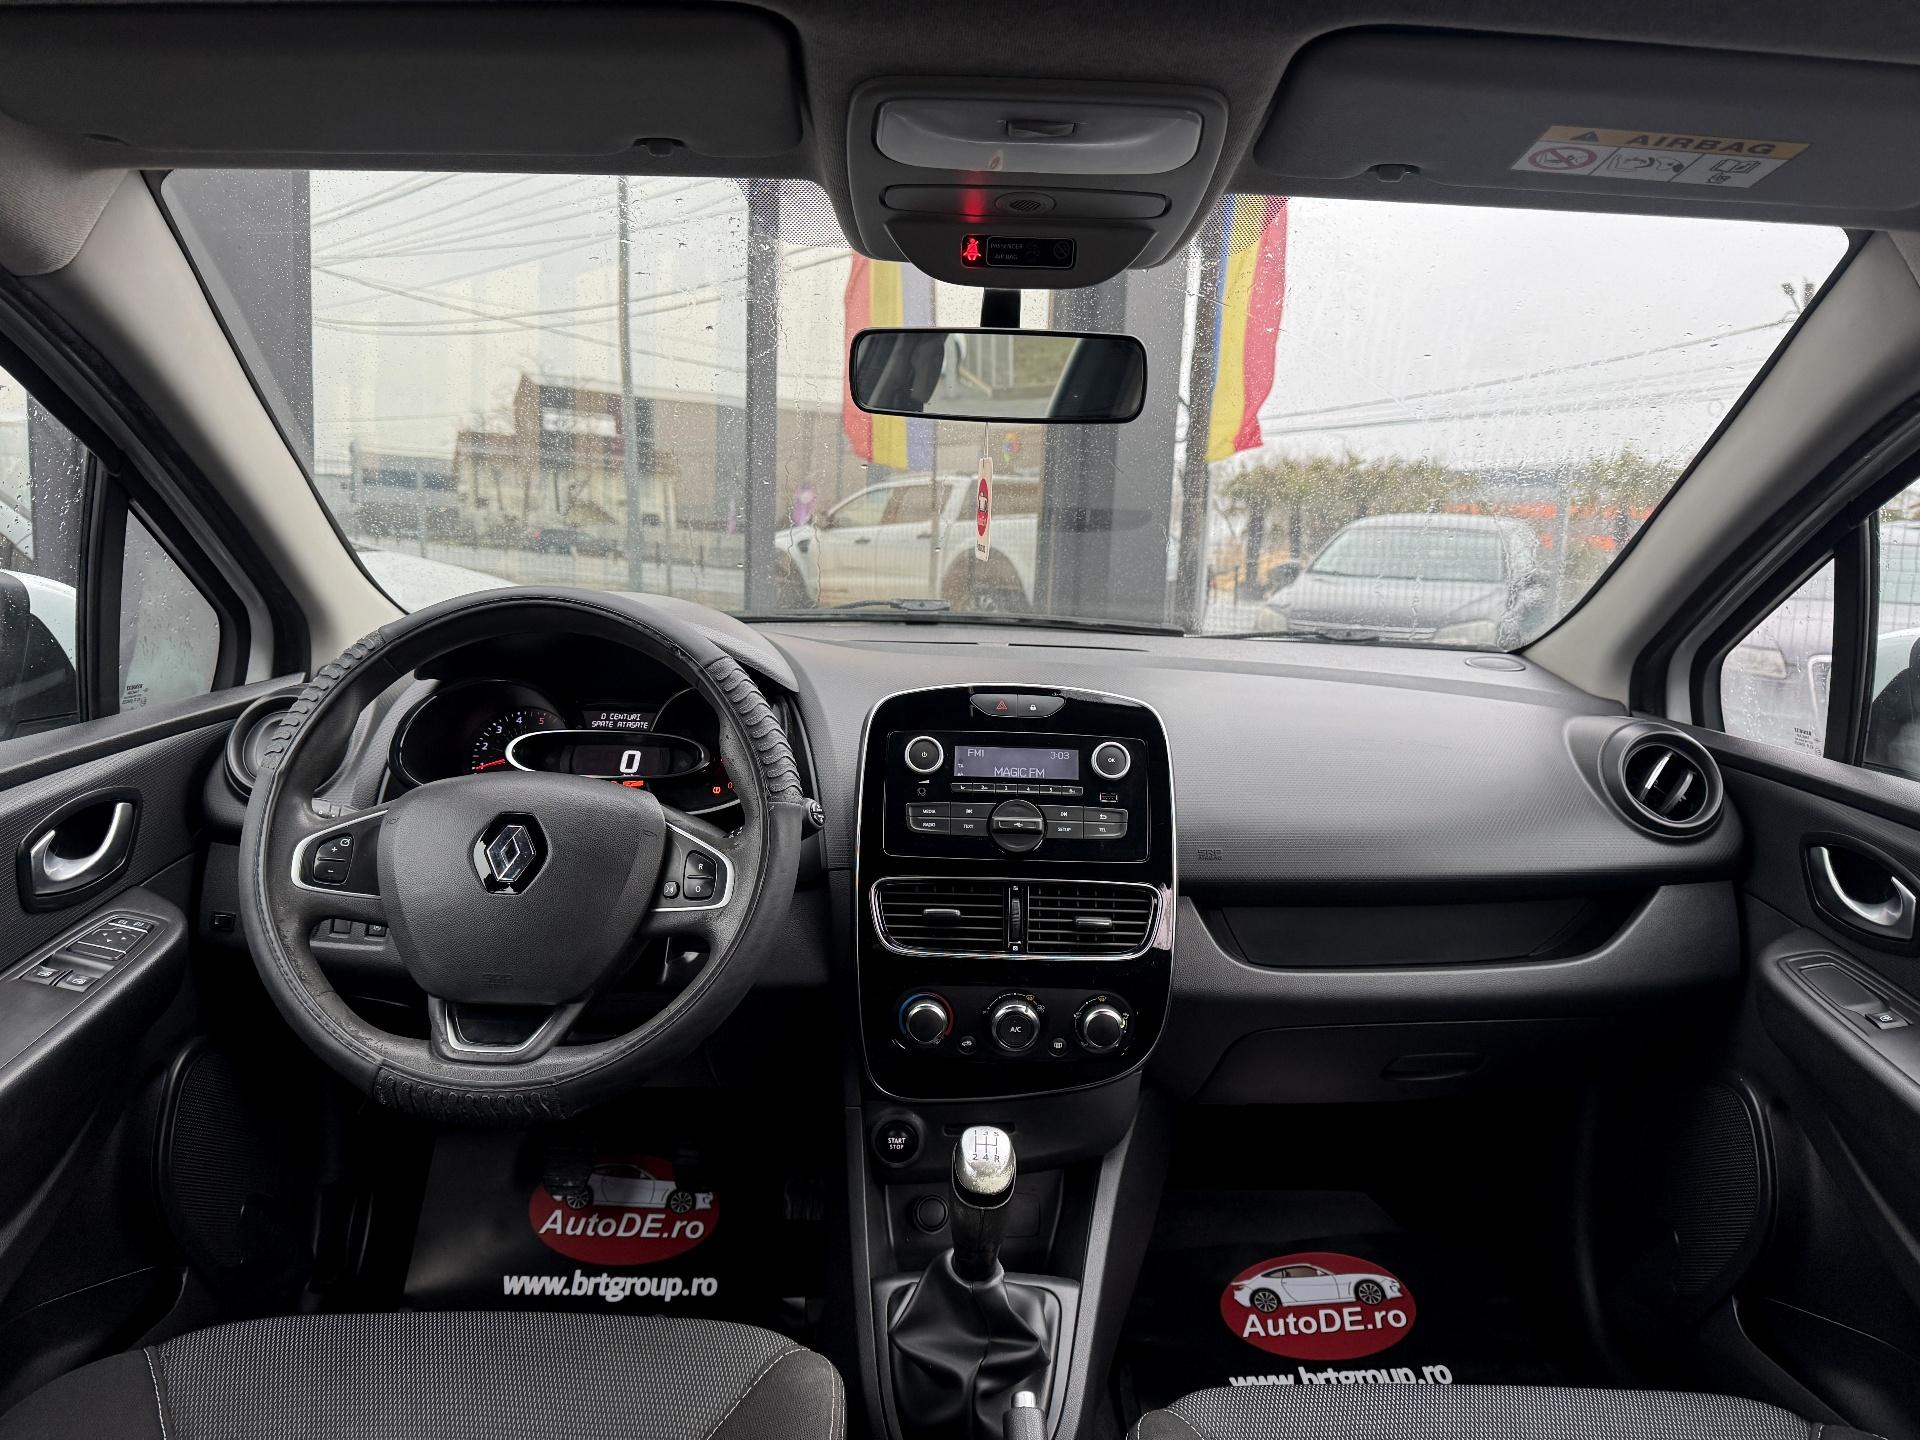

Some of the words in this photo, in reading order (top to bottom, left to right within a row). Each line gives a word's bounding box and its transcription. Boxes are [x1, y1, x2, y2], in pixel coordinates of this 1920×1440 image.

[1624, 133, 1777, 156] AIRBAG
[515, 716, 522, 724] 4
[538, 717, 545, 725] 5
[609, 712, 641, 721] CENTURI
[495, 725, 503, 734] 3
[591, 720, 614, 728] SPATE
[616, 721, 649, 729] ATASATE
[481, 742, 489, 750] 2
[619, 749, 642, 774] 0
[994, 766, 1028, 778] MAGIC
[1028, 767, 1045, 779] FM
[972, 1153, 979, 1161] 2
[982, 1153, 990, 1161] 4
[994, 1154, 1000, 1163] R
[538, 1208, 705, 1240] AutoDE.ro
[503, 1269, 718, 1303] www.brtgroup.ro
[1242, 1306, 1408, 1338] AutoDE.ro
[1229, 1364, 1453, 1387] wwwbrtgroup.ro
